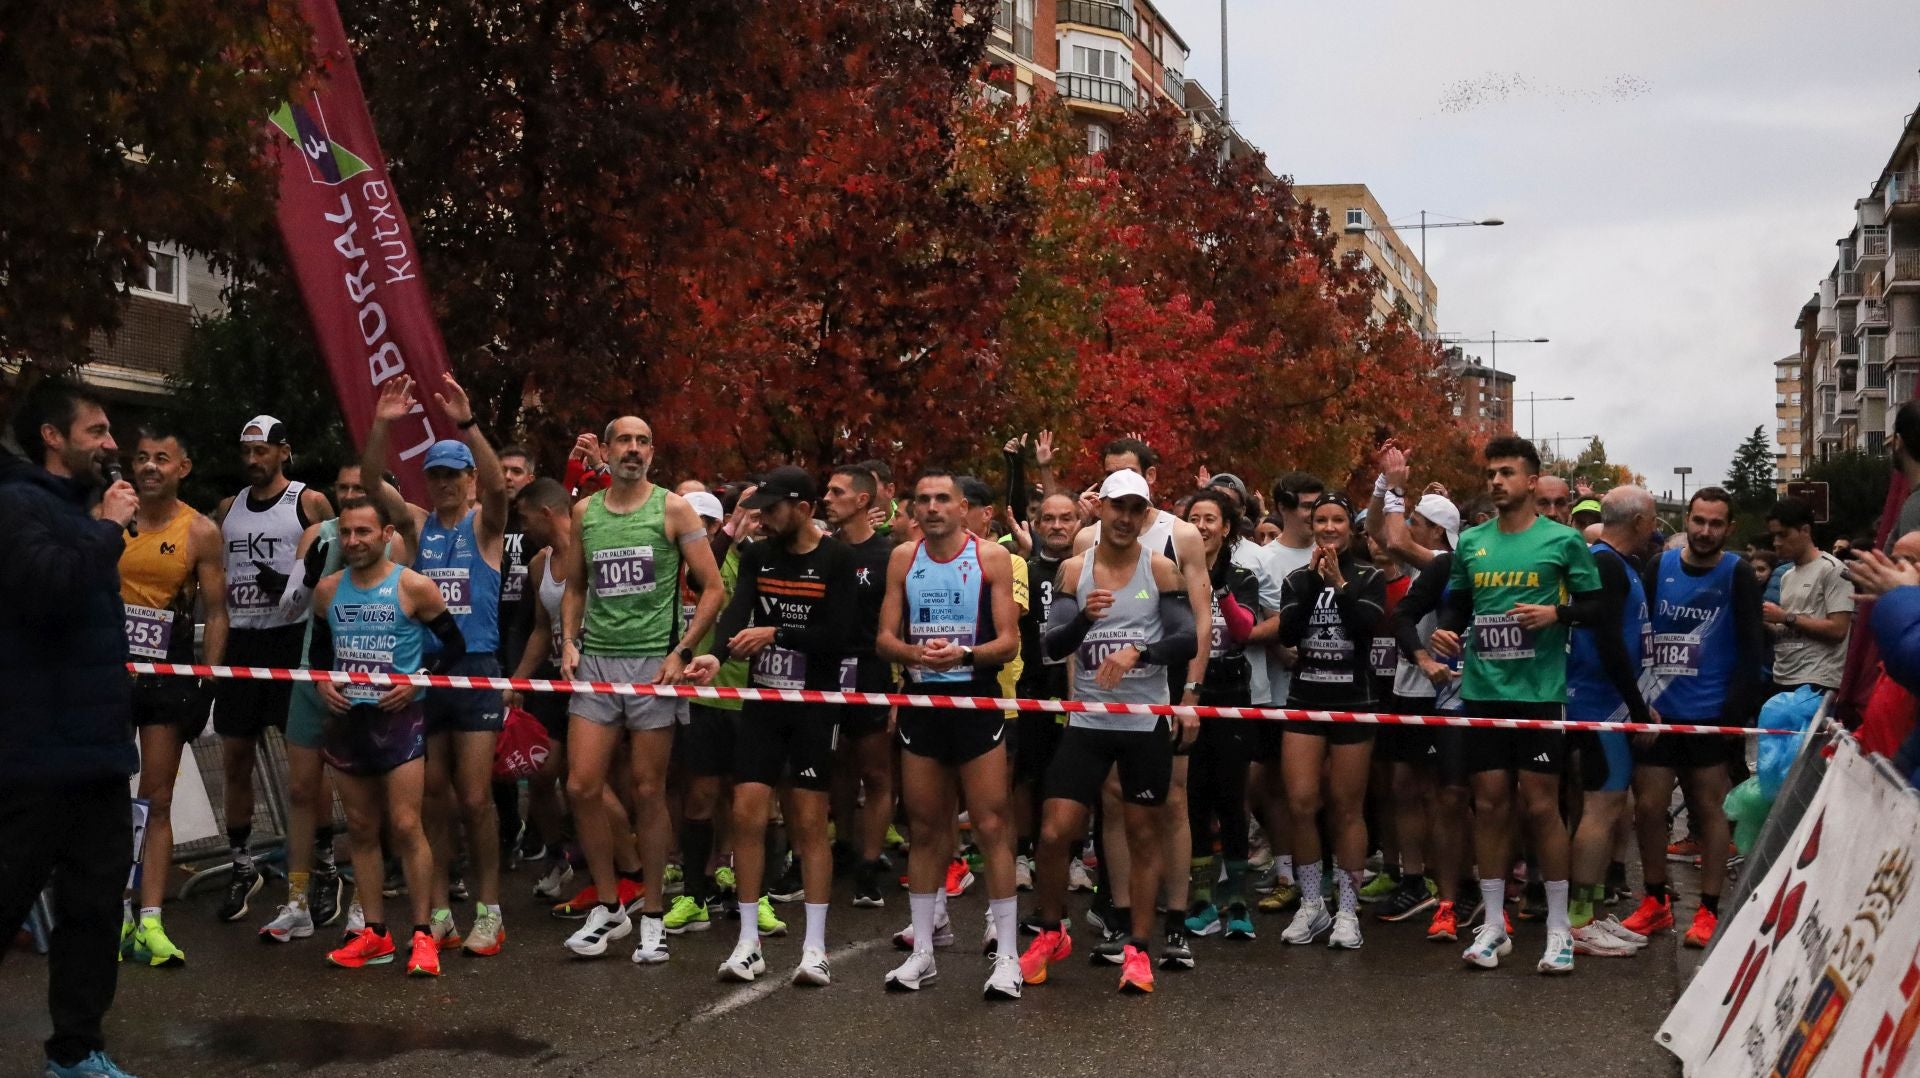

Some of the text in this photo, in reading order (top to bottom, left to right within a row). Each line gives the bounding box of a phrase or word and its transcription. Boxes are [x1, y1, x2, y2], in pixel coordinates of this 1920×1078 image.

[609, 549, 636, 558] PALENCIA
[601, 560, 644, 584] 1015
[127, 606, 156, 618] PALENCIA
[780, 602, 812, 614] VICKY
[1659, 599, 1720, 622] Deproal
[361, 610, 396, 623] ULSA
[781, 612, 808, 620] FOODS
[926, 625, 955, 633] PALENCIA
[1099, 631, 1127, 639] PALENCIA
[1480, 627, 1522, 648] 1010
[349, 651, 376, 660] PALENCIA
[1369, 648, 1387, 666] 67
[1656, 645, 1689, 664] 1184
